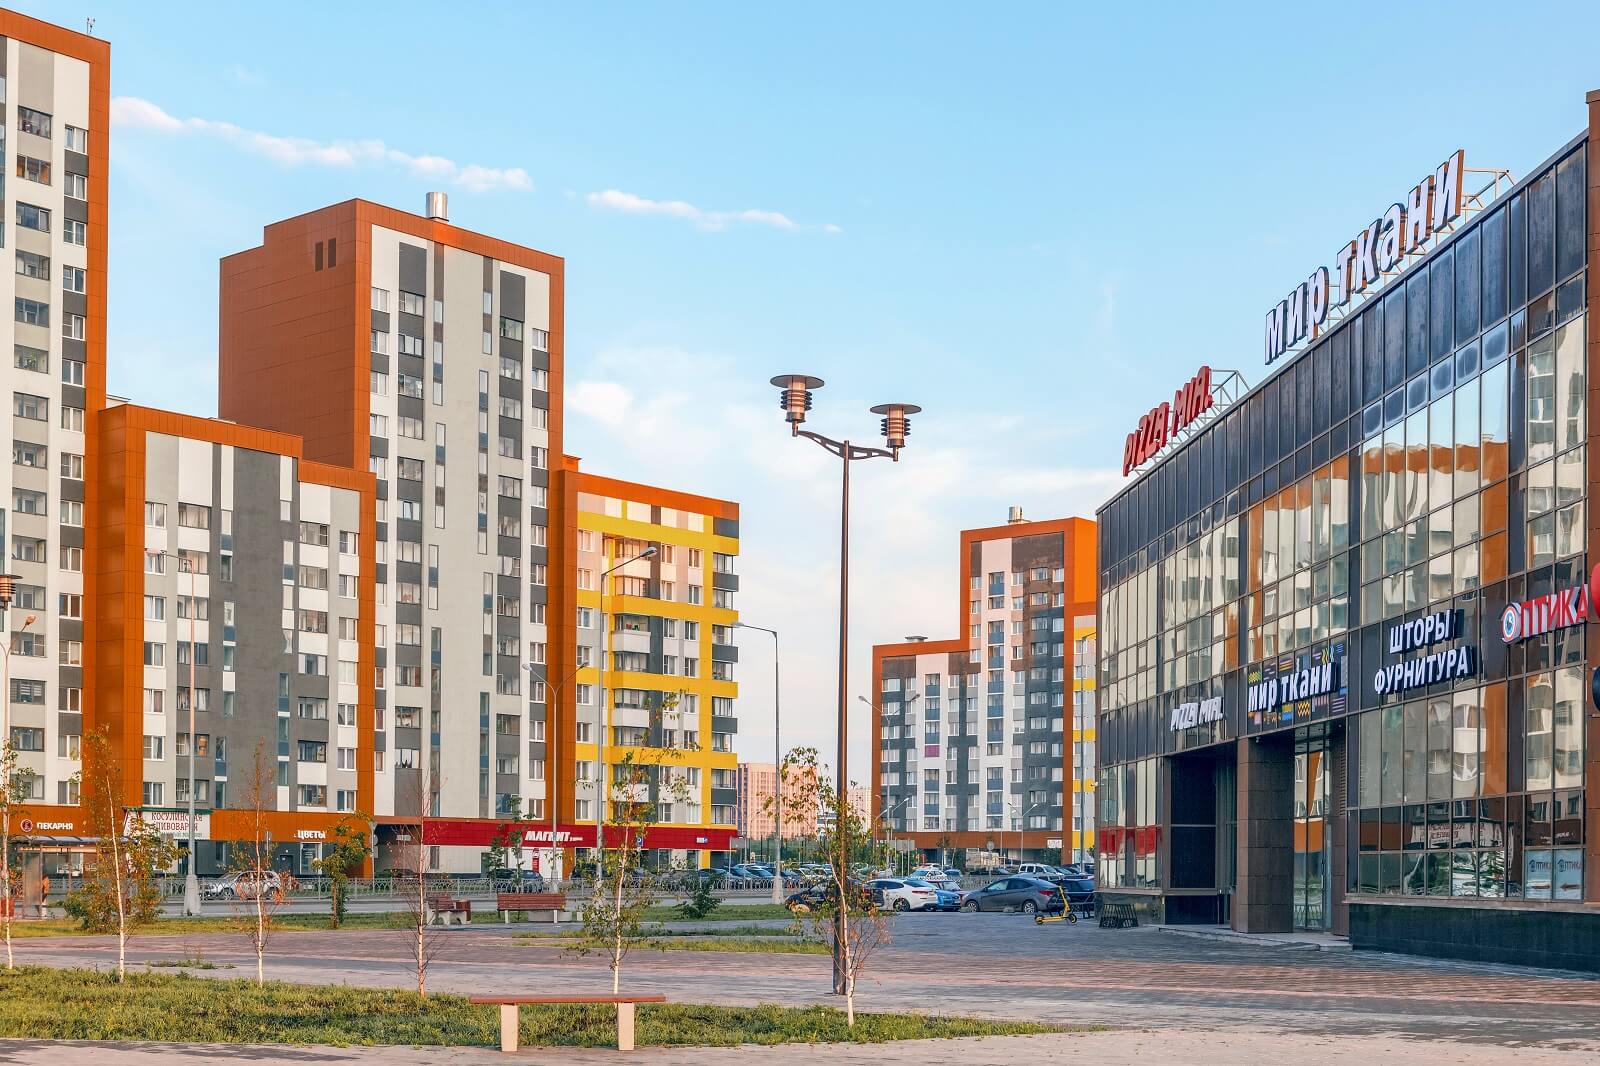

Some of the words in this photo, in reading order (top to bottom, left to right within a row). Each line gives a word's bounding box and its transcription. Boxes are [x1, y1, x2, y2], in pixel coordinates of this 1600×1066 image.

[1123, 402, 1169, 477] PIZZA
[1390, 609, 1453, 654] ШТОРЫ
[1374, 645, 1471, 694] ФУРНИТУРА
[1171, 702, 1198, 732] PIZZA
[36, 822, 73, 830] ПЕКАРНЯ
[297, 830, 326, 840] ЦВЕТЫ
